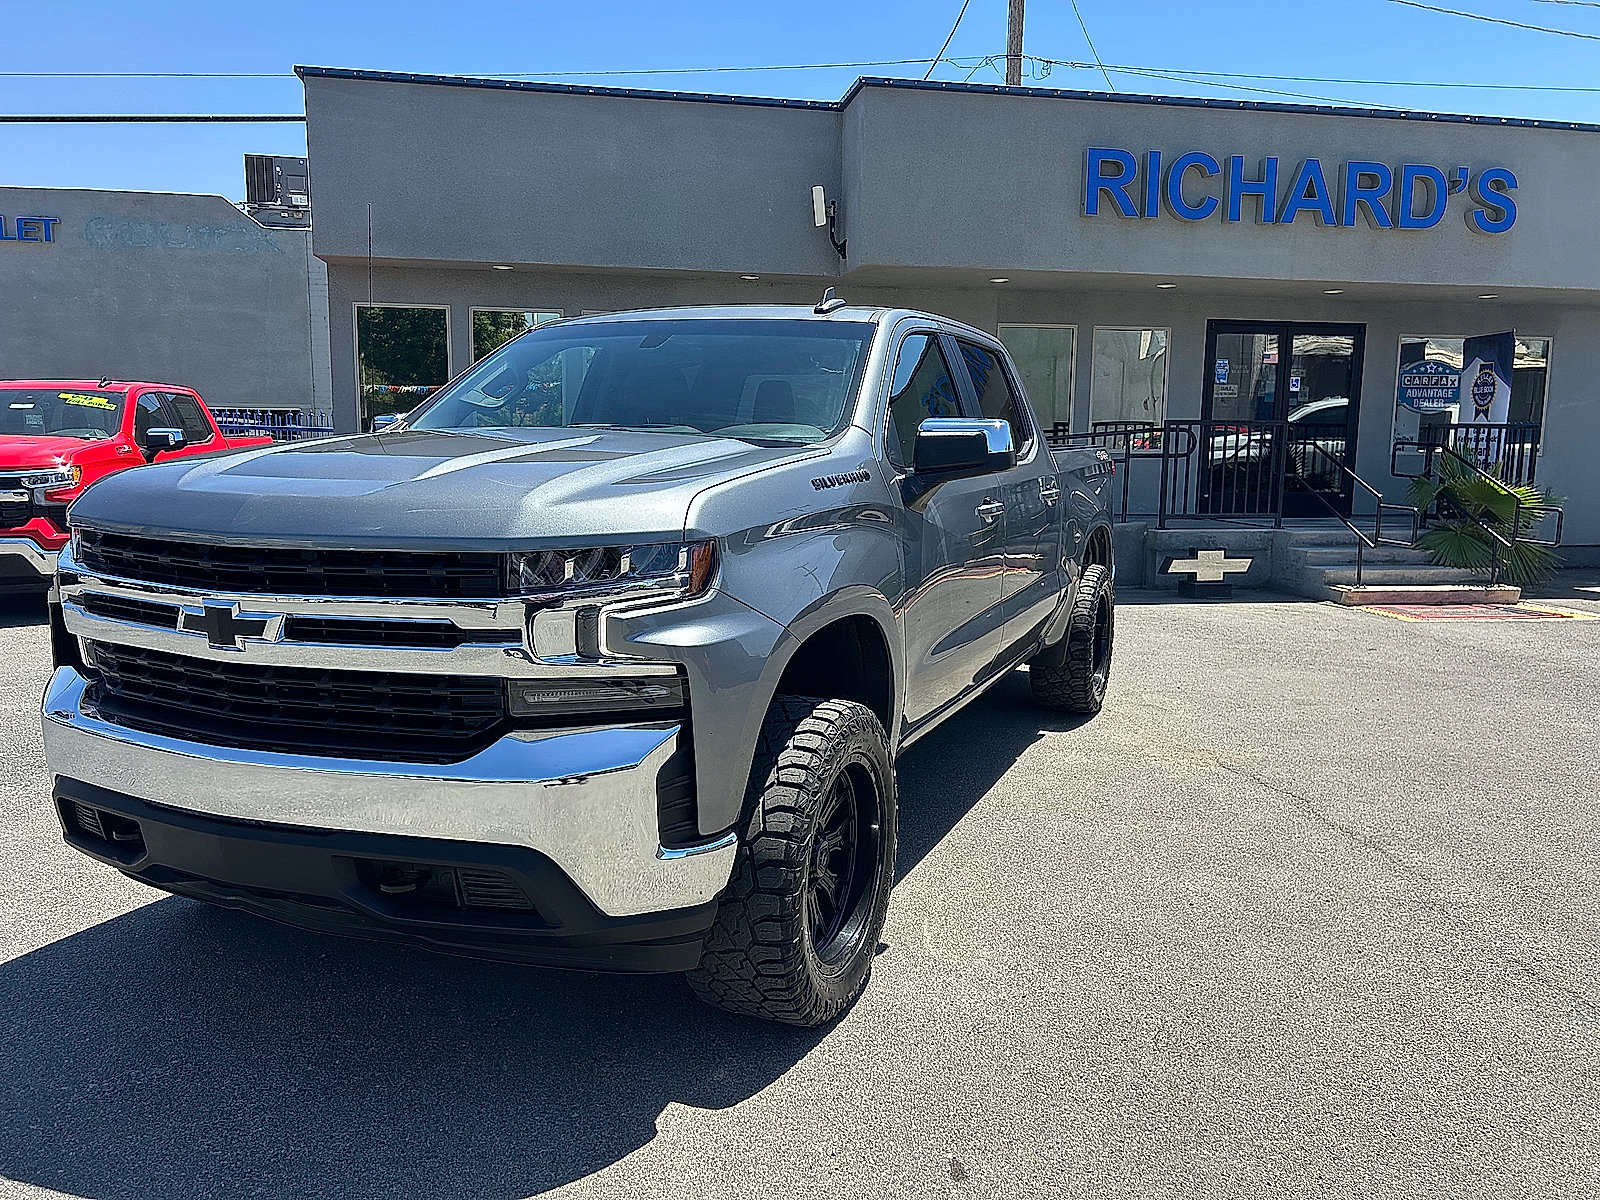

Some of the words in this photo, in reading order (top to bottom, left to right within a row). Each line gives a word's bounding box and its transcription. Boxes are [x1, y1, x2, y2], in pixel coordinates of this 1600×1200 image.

[1083, 146, 1518, 234] RICHARD'S
[1404, 376, 1457, 387] CARFAX
[1406, 388, 1454, 398] ADVANTAGE
[1413, 398, 1445, 408] DEALER
